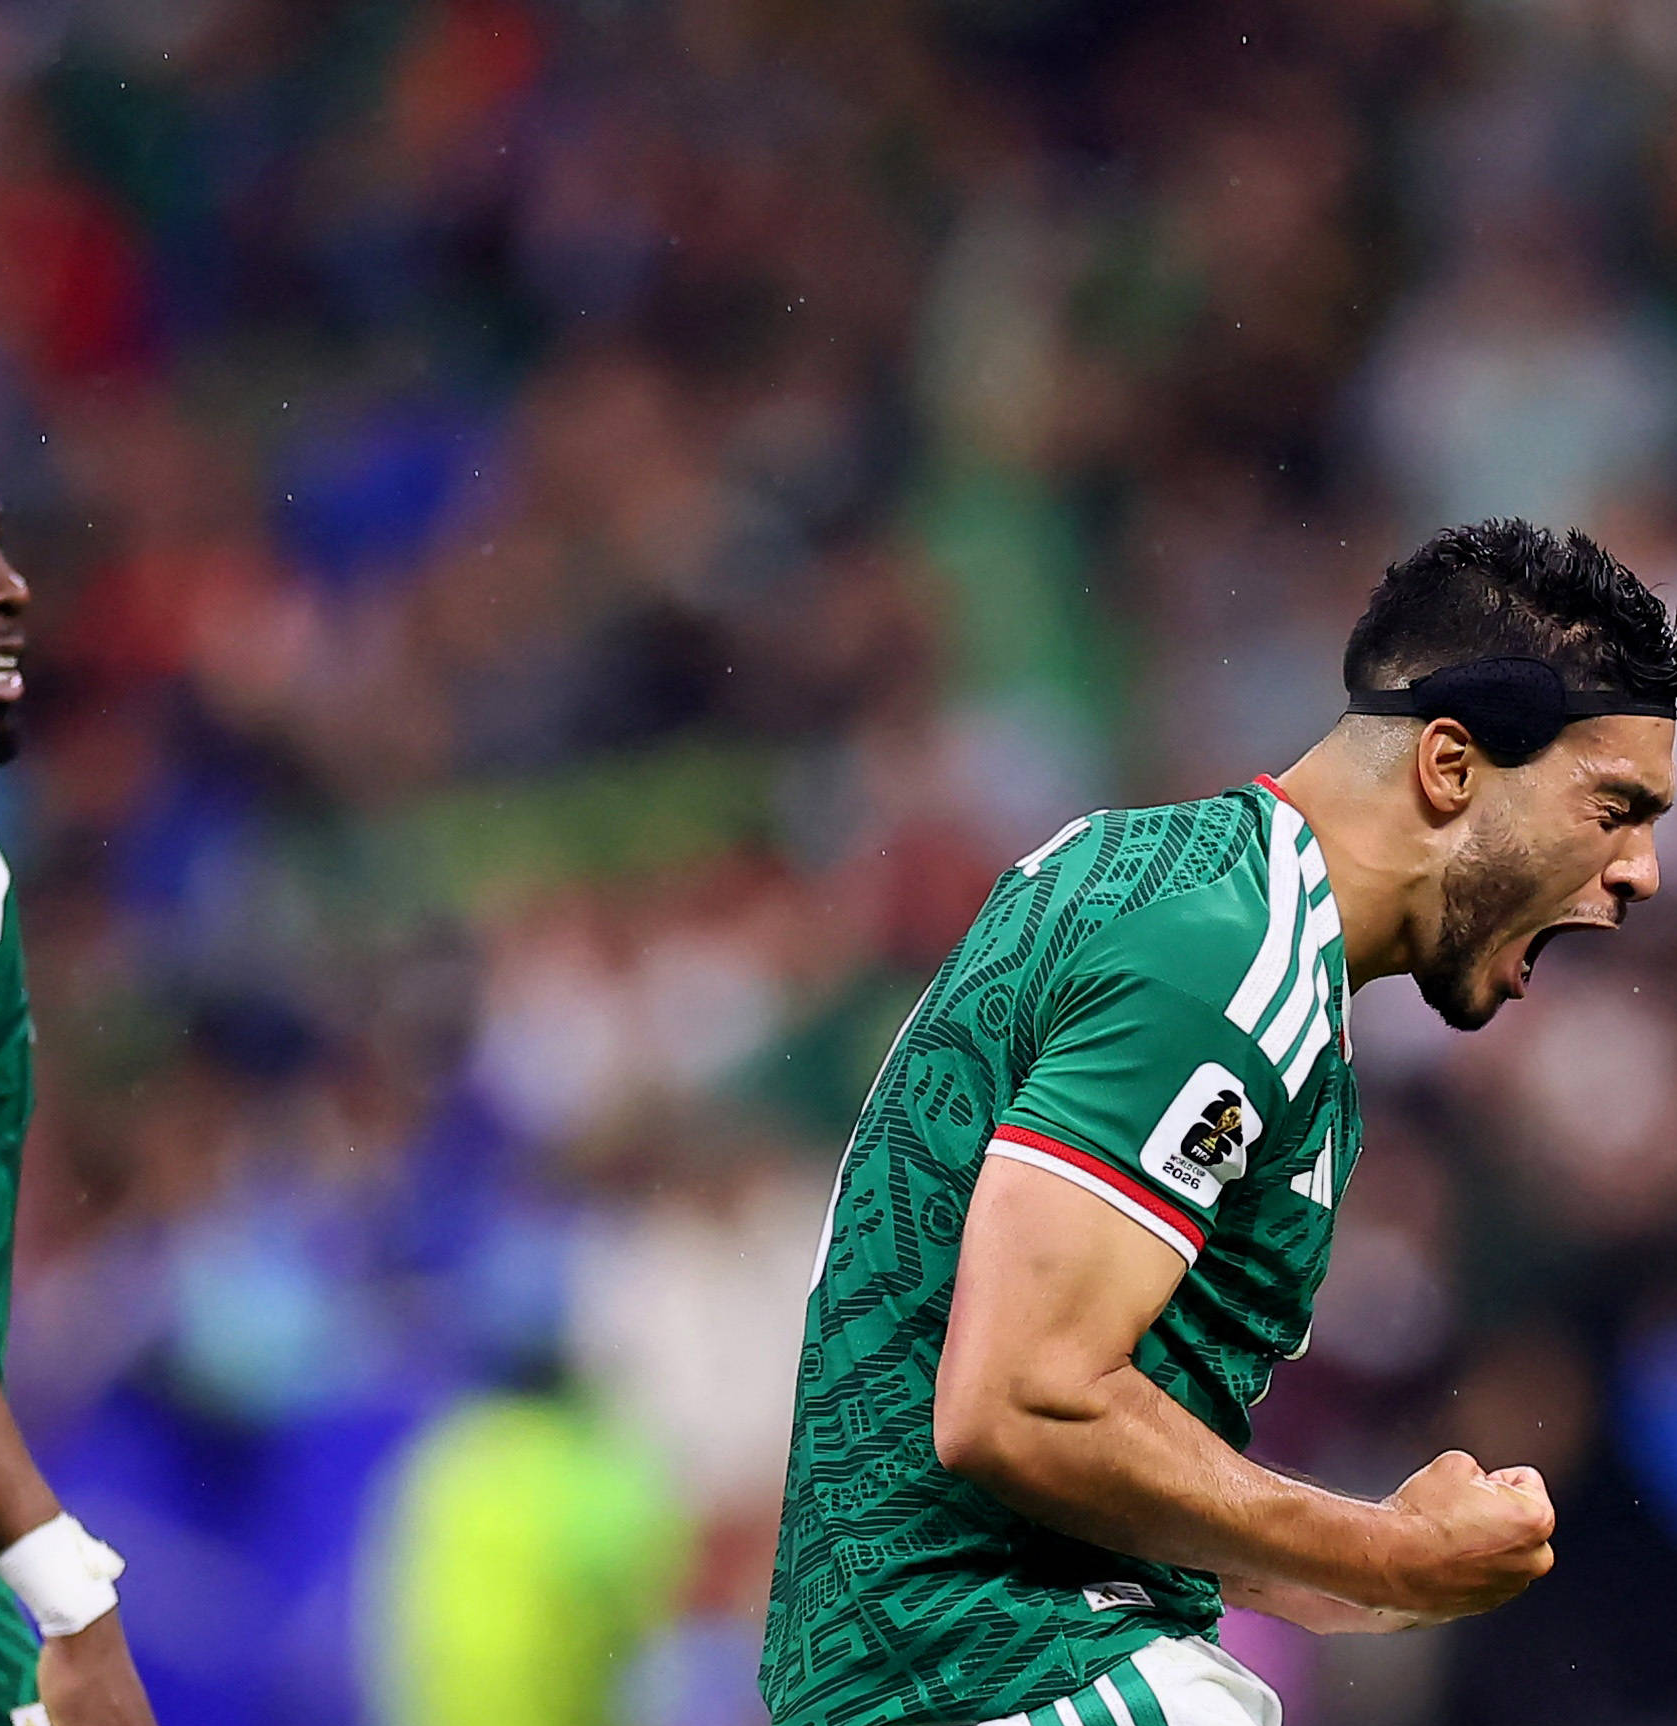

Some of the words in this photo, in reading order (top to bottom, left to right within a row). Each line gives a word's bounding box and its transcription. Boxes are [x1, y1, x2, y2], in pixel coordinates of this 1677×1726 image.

[1191, 1146, 1210, 1161] FIFA
[1163, 1162, 1200, 1189] 2026
[1170, 1154, 1192, 1170] WORLD
[1193, 1166, 1206, 1177] CUP
